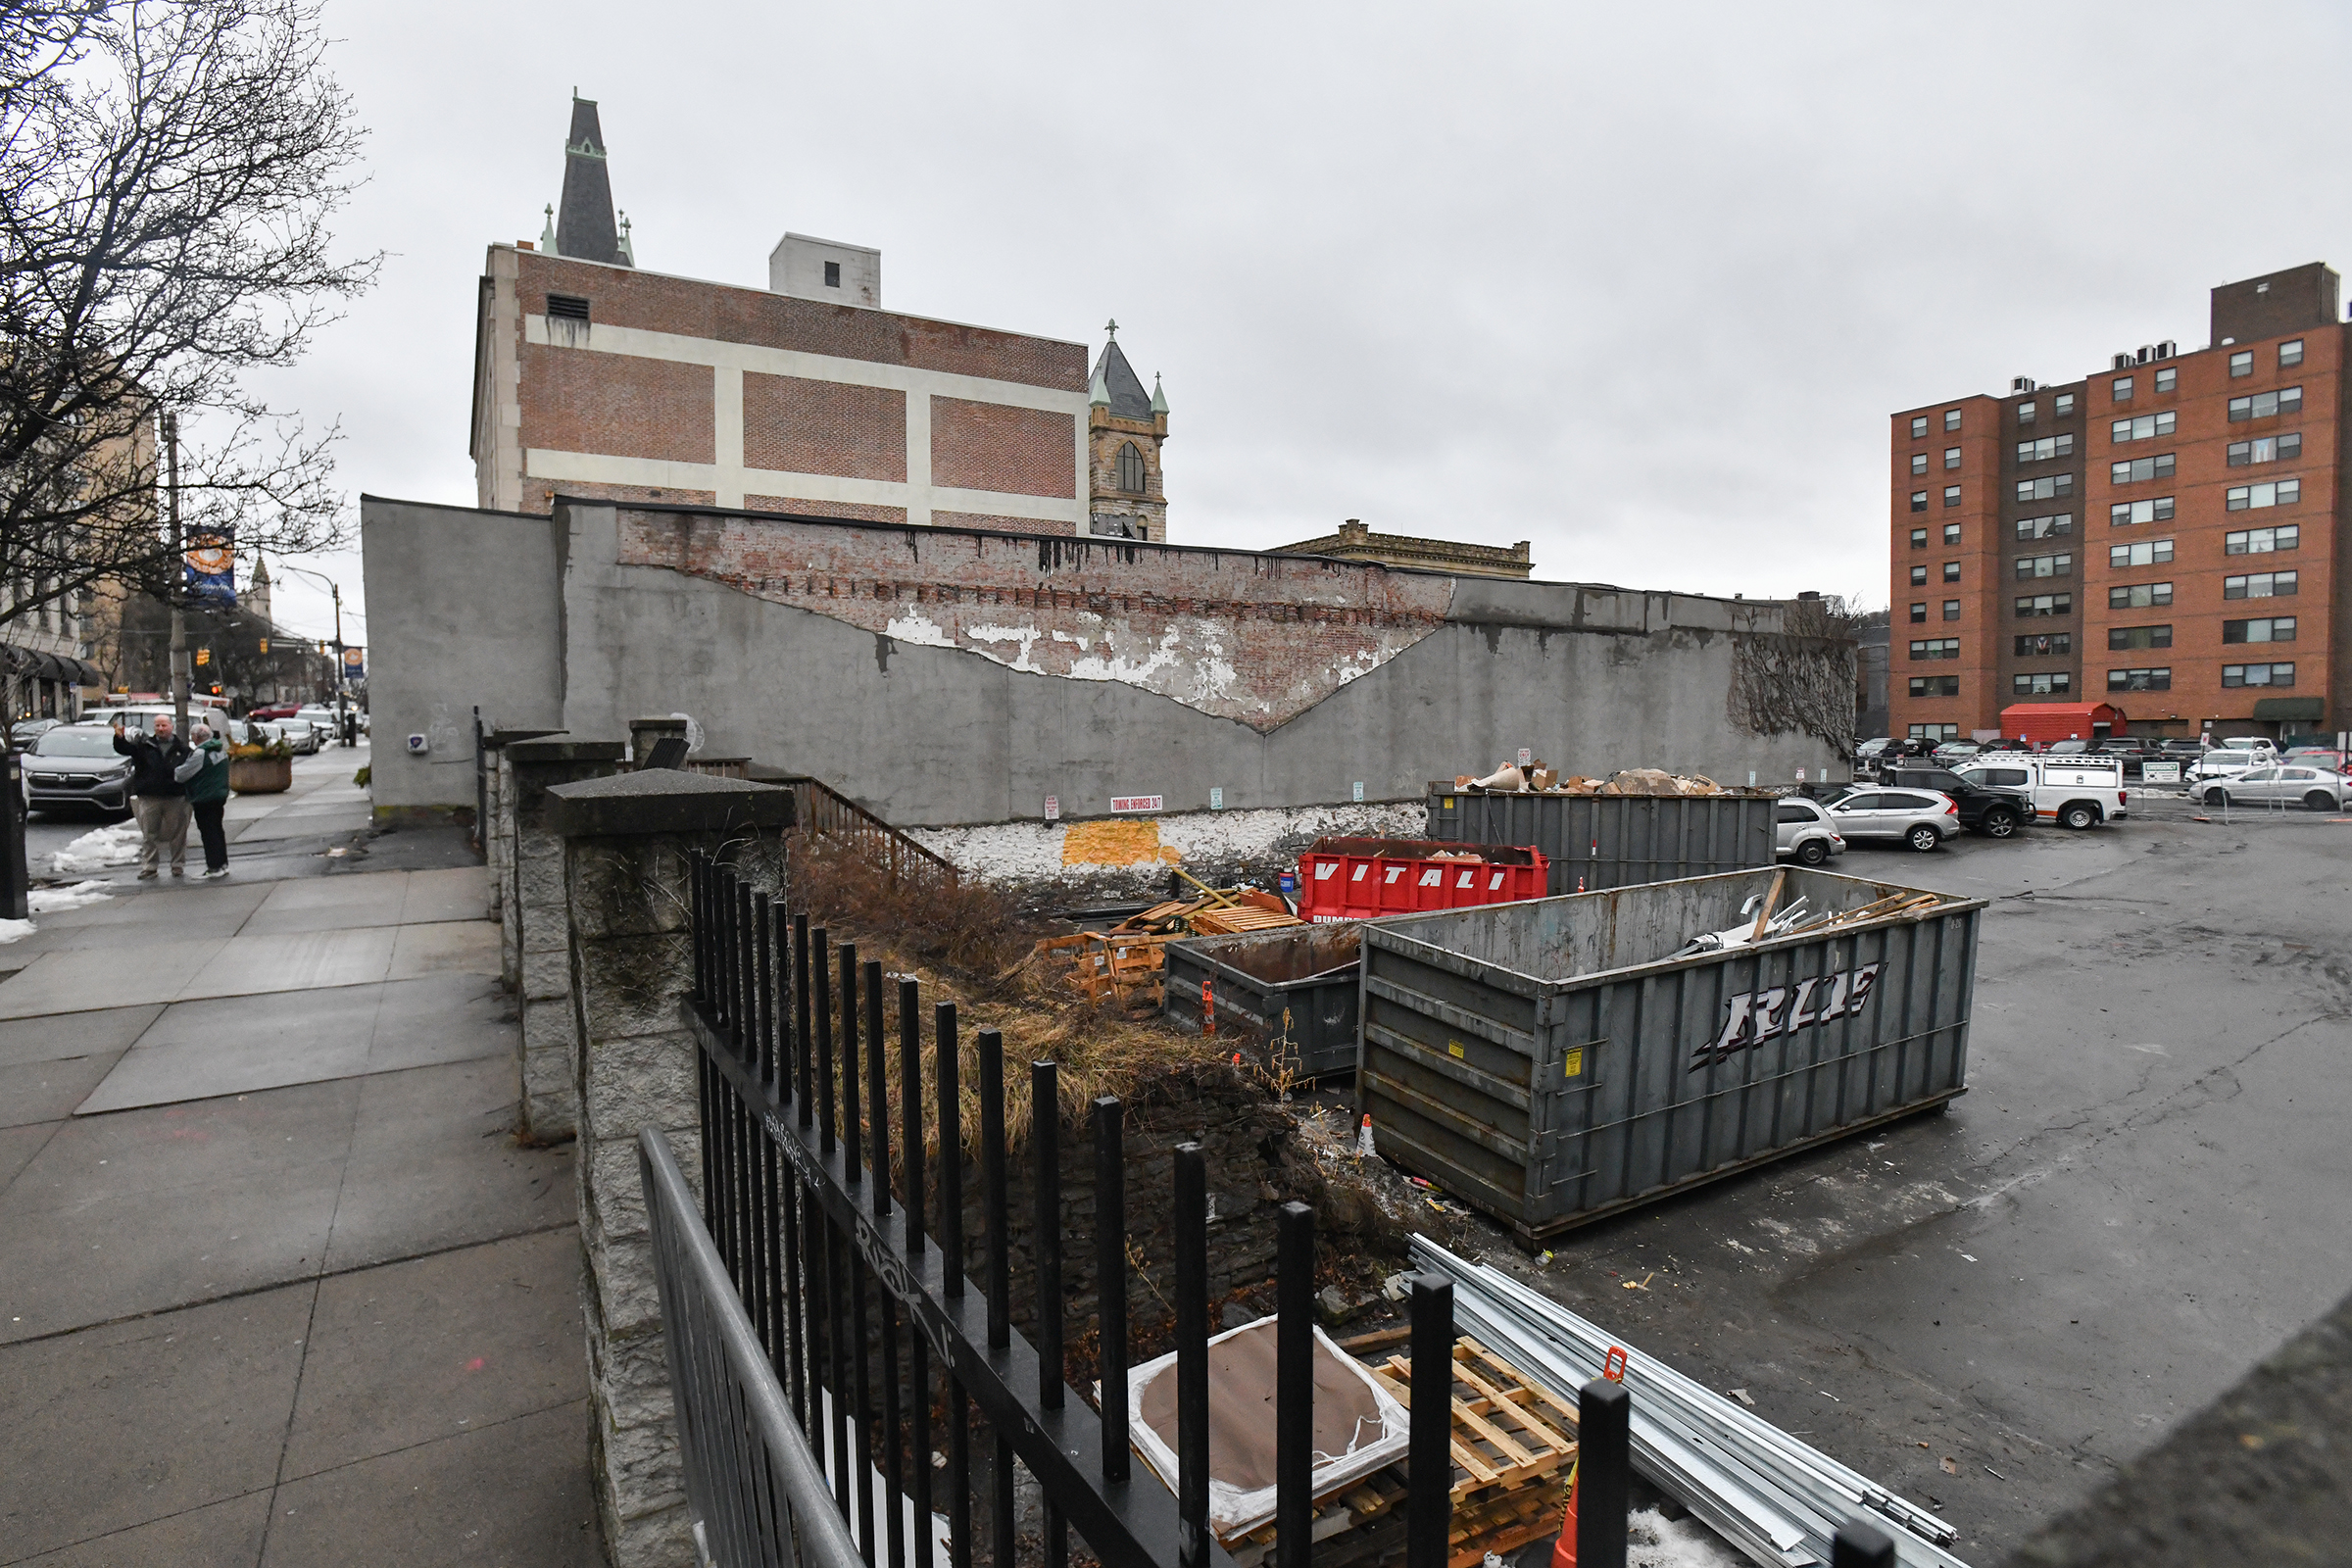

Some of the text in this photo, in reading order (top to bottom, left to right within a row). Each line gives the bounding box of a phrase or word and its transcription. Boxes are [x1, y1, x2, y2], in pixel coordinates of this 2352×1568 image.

[1112, 797, 1161, 811] TOWING ENFORCED 24/7
[1314, 862, 1505, 891] VITALI
[1313, 914, 1361, 923] DUMP
